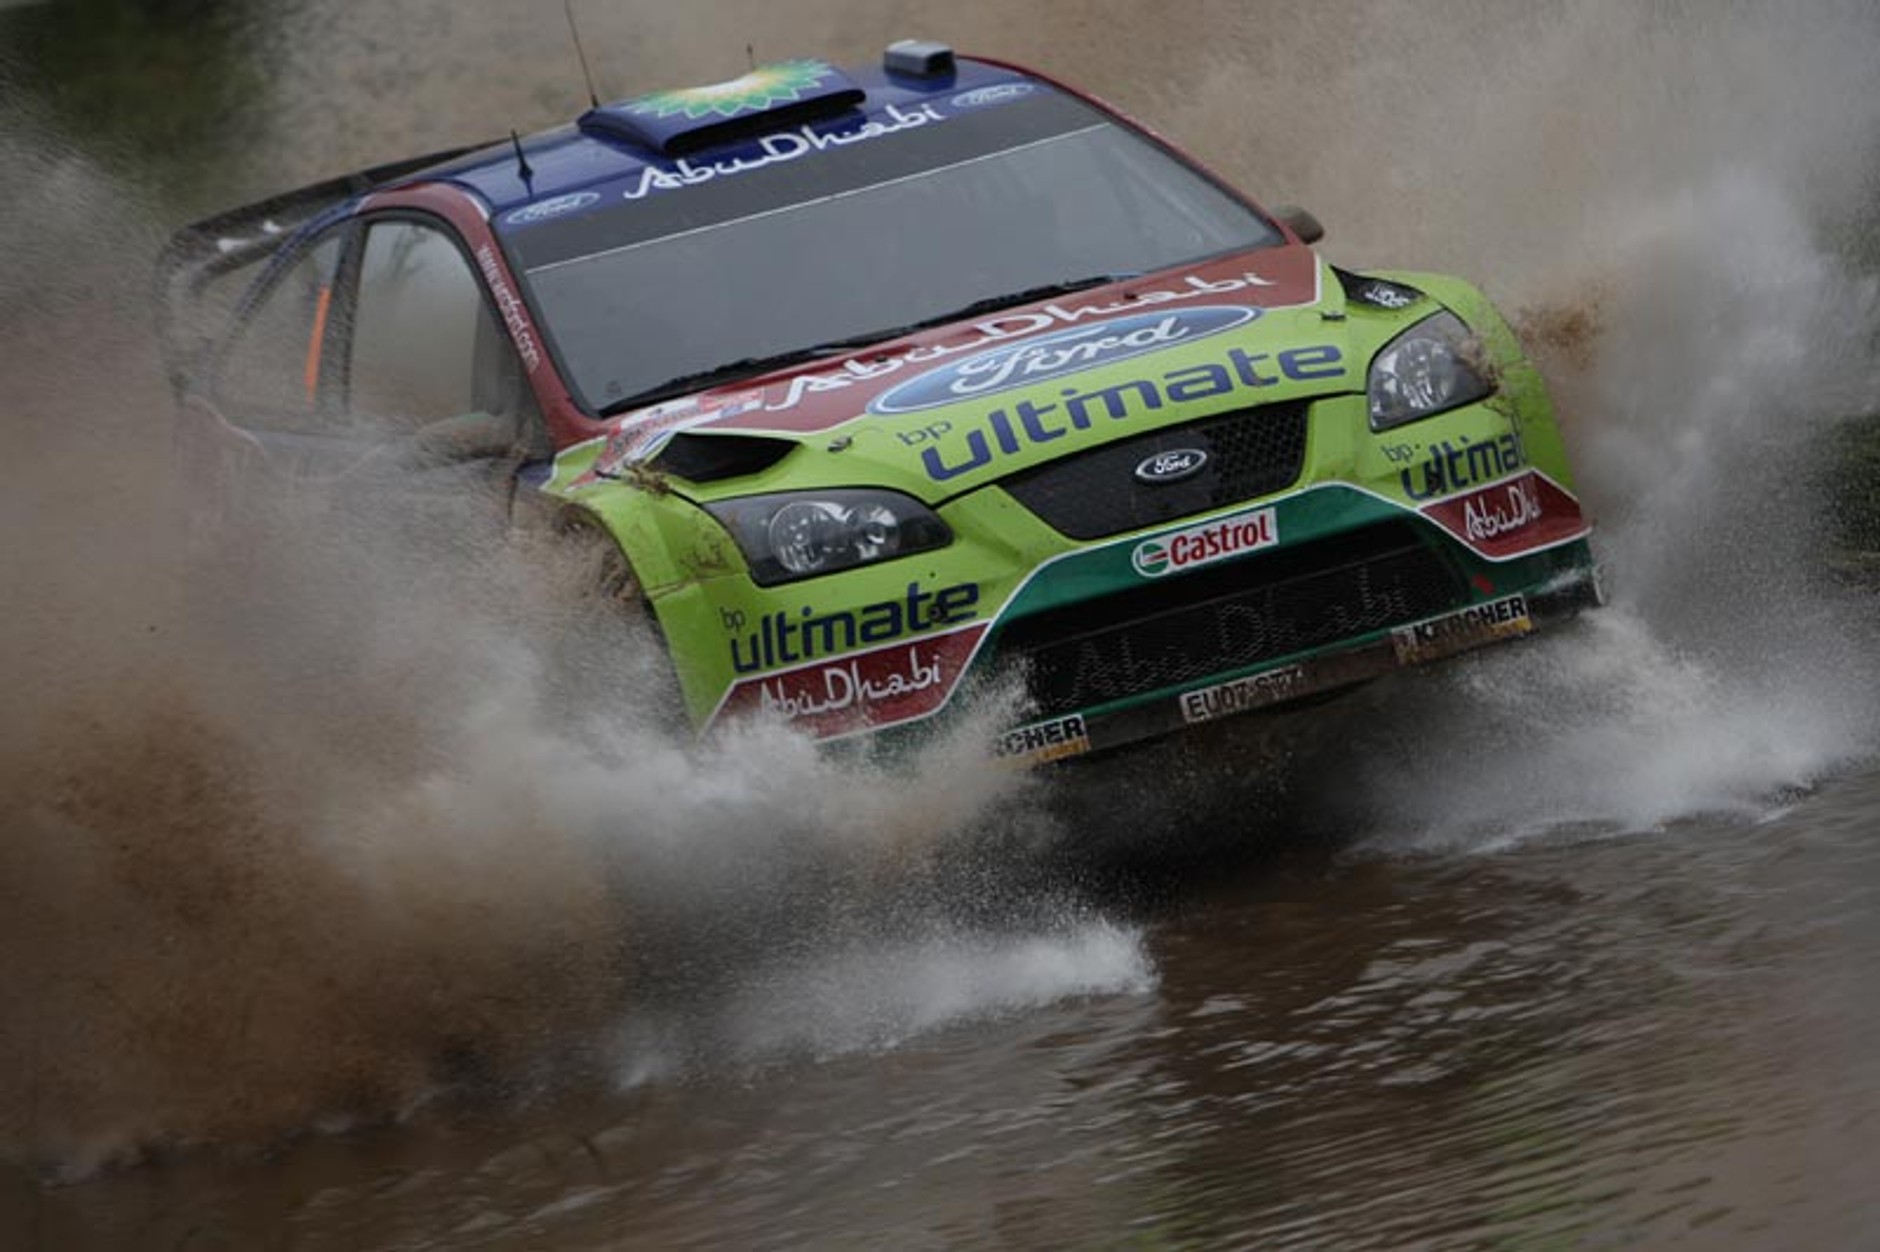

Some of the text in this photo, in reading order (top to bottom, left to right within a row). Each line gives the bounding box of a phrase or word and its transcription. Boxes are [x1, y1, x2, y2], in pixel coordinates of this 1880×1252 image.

[953, 304, 1196, 396] Ford
[896, 420, 954, 446] bp
[919, 344, 1347, 482] ultimate
[1154, 451, 1191, 474] Ford
[1380, 443, 1413, 463] bp
[1170, 513, 1272, 566] Castrol
[720, 605, 747, 632] bp
[730, 580, 981, 674] ultimate
